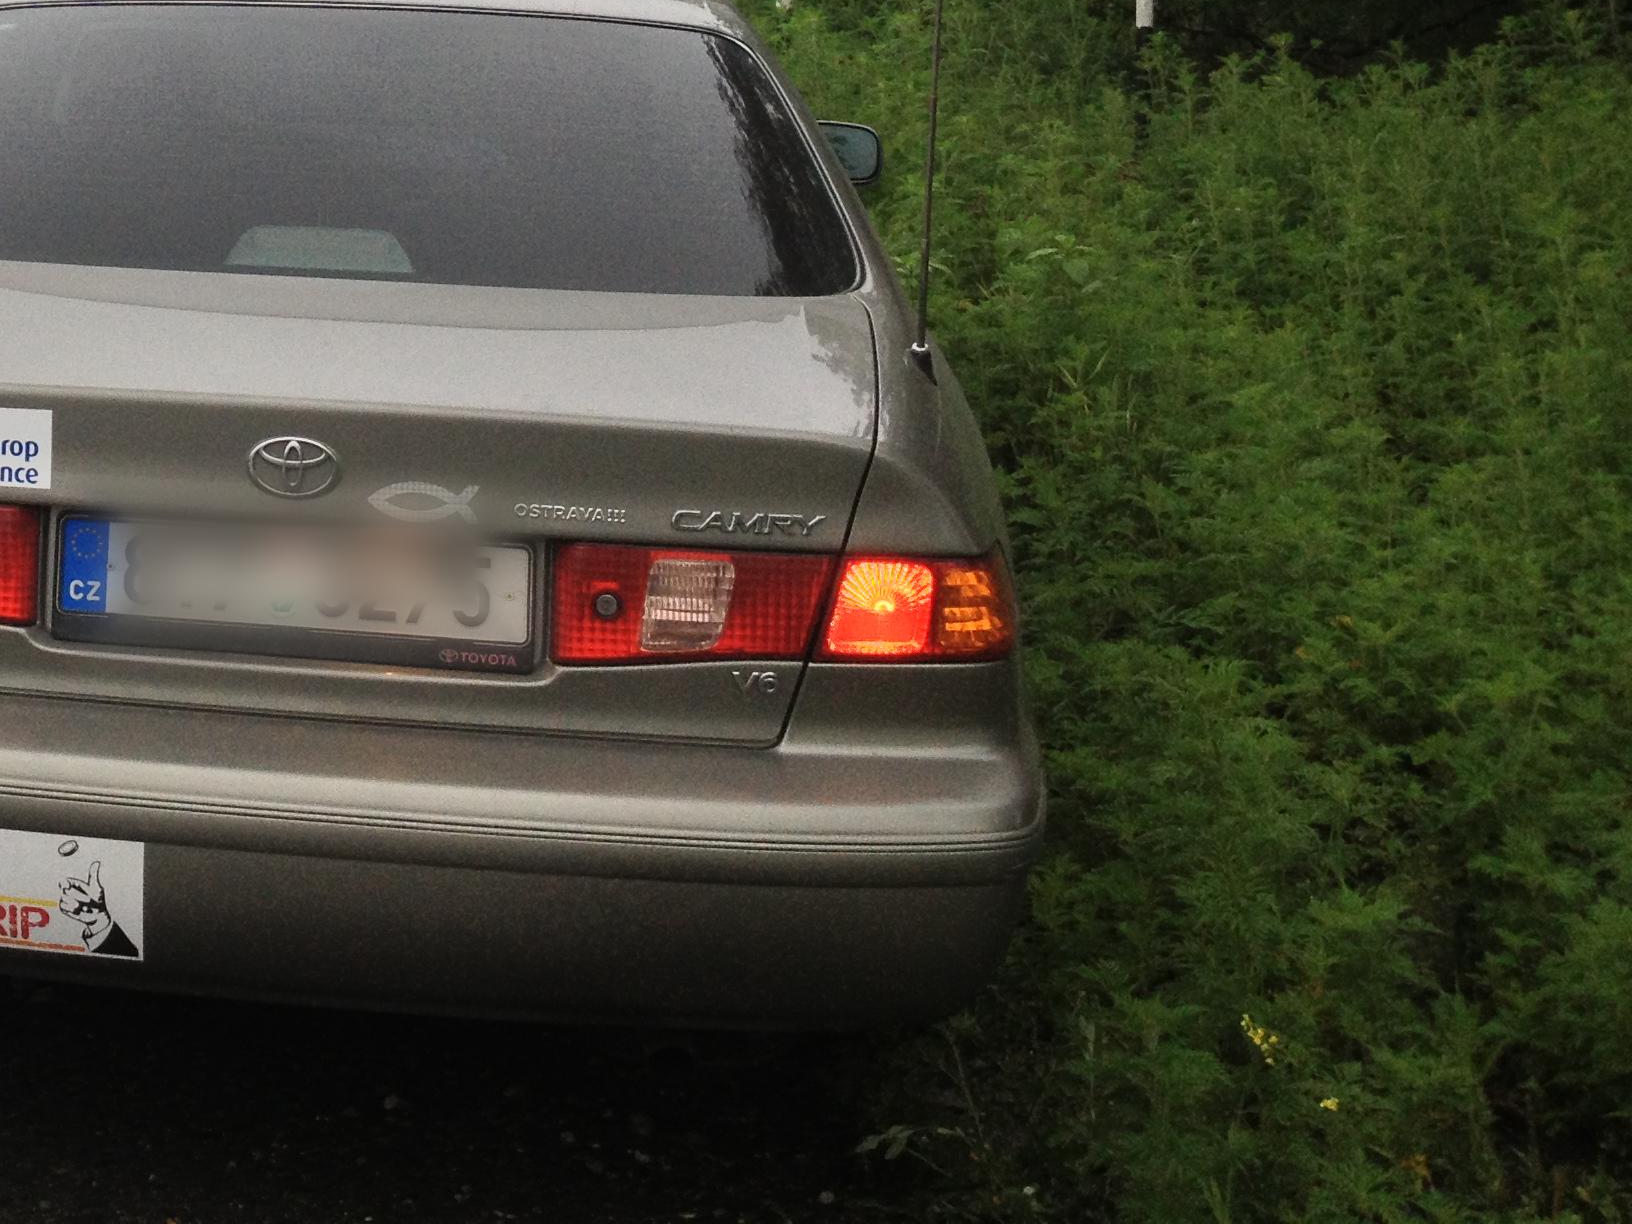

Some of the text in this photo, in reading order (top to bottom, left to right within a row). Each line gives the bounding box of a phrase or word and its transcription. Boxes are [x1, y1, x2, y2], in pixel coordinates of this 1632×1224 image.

[671, 509, 826, 536] CAMRY
[68, 579, 101, 602] CZ
[461, 650, 518, 667] TOYOTA
[731, 670, 778, 693] V6
